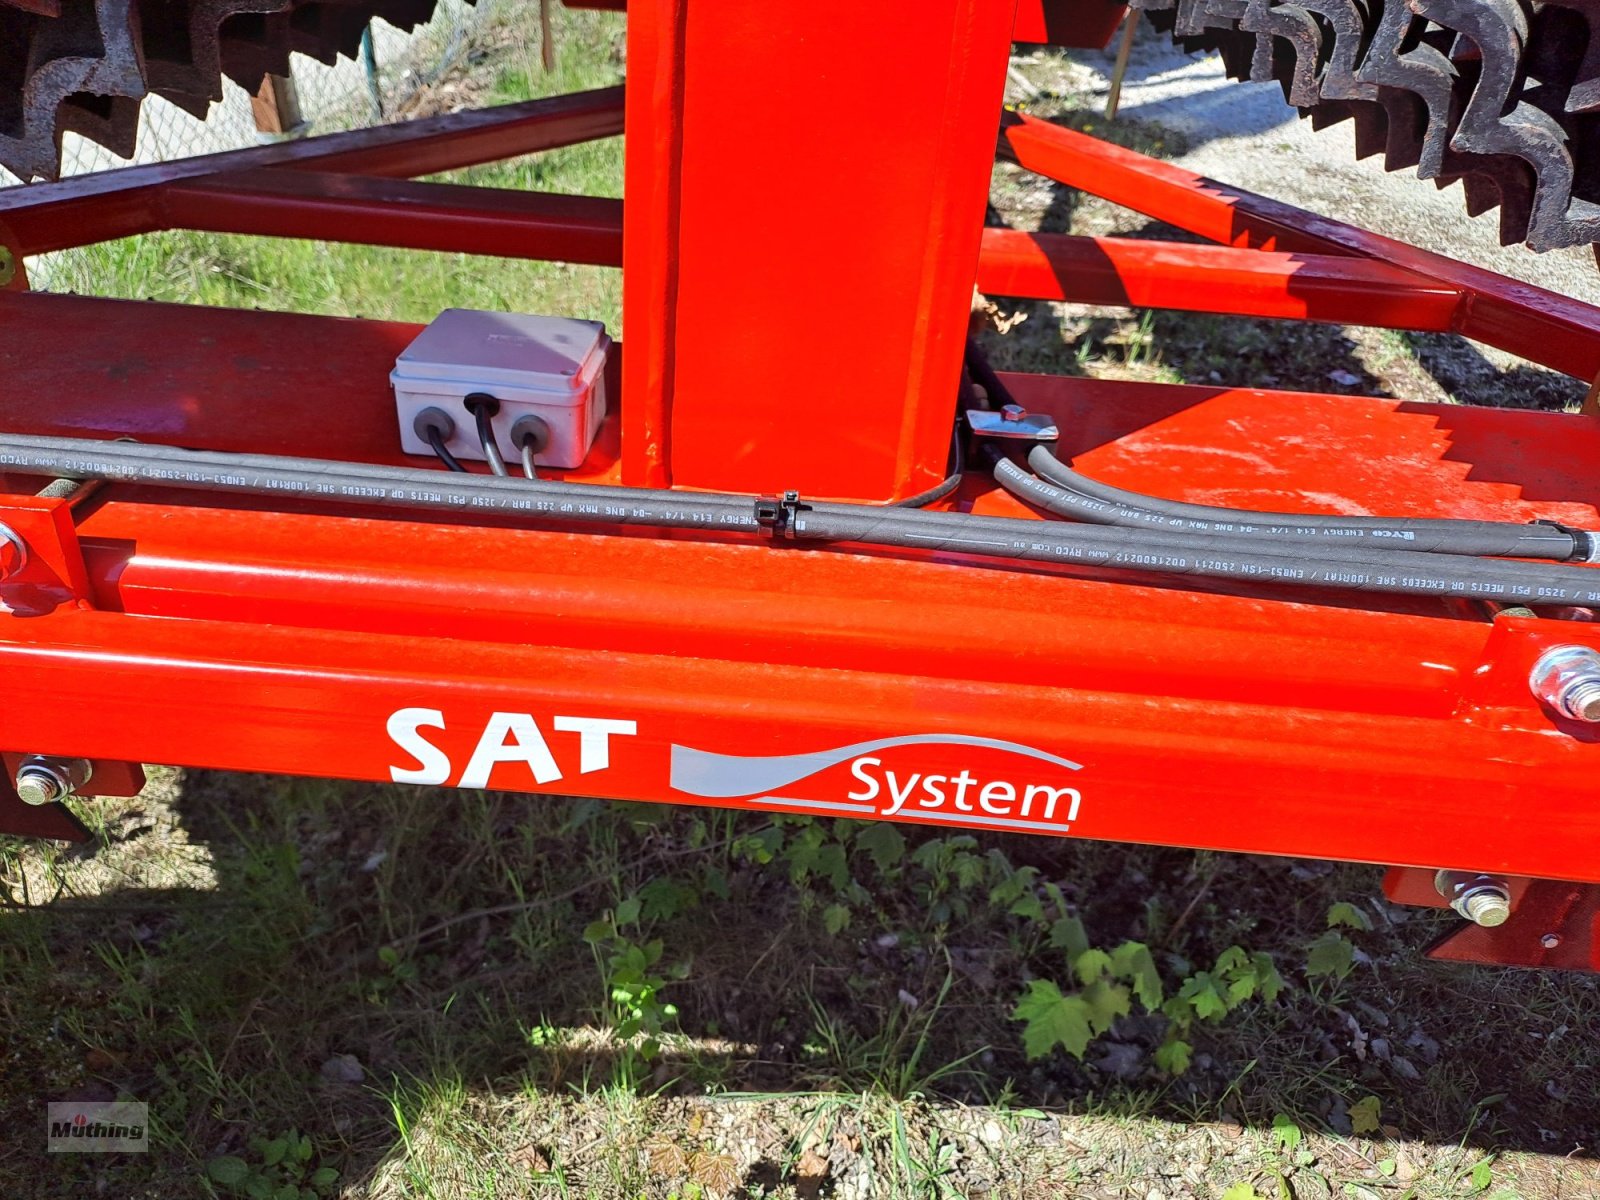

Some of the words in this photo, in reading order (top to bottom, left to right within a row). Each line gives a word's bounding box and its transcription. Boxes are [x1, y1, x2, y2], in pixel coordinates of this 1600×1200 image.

[265, 479, 310, 491] 100R1AT
[316, 483, 335, 494] SAE
[342, 485, 387, 498] EXCEEDS
[391, 489, 404, 499] OR
[410, 491, 441, 503] MEETS
[448, 494, 466, 505] PSI
[472, 496, 495, 508] 3250
[512, 499, 531, 510] BAR
[1060, 494, 1079, 504] PSI
[1081, 498, 1106, 511] 3250
[536, 501, 555, 511] 225
[560, 502, 573, 513] WP
[578, 503, 599, 514] MAX
[692, 512, 712, 523] E14
[1119, 509, 1140, 519] BAR
[1144, 514, 1164, 524] 225
[1168, 519, 1183, 527] WP
[1188, 521, 1209, 530] MAX
[1213, 523, 1233, 532] DN6
[1323, 529, 1364, 537] ENERGY
[1013, 539, 1026, 548] au
[1031, 543, 1051, 553] com
[1055, 545, 1082, 558] RYCO
[1115, 552, 1186, 568] 0021600212
[1194, 559, 1235, 572] 250211
[1241, 563, 1304, 579] EN853-1SN
[1323, 571, 1370, 585] 100R1AT
[1375, 575, 1396, 586] SAE
[1402, 577, 1445, 590] EXCEEDS
[1450, 581, 1465, 591] OR
[1470, 582, 1505, 593] MEETS
[1511, 585, 1531, 596] PSI
[1537, 587, 1567, 598] 3250
[386, 707, 637, 789] SAT
[848, 757, 1082, 821] System
